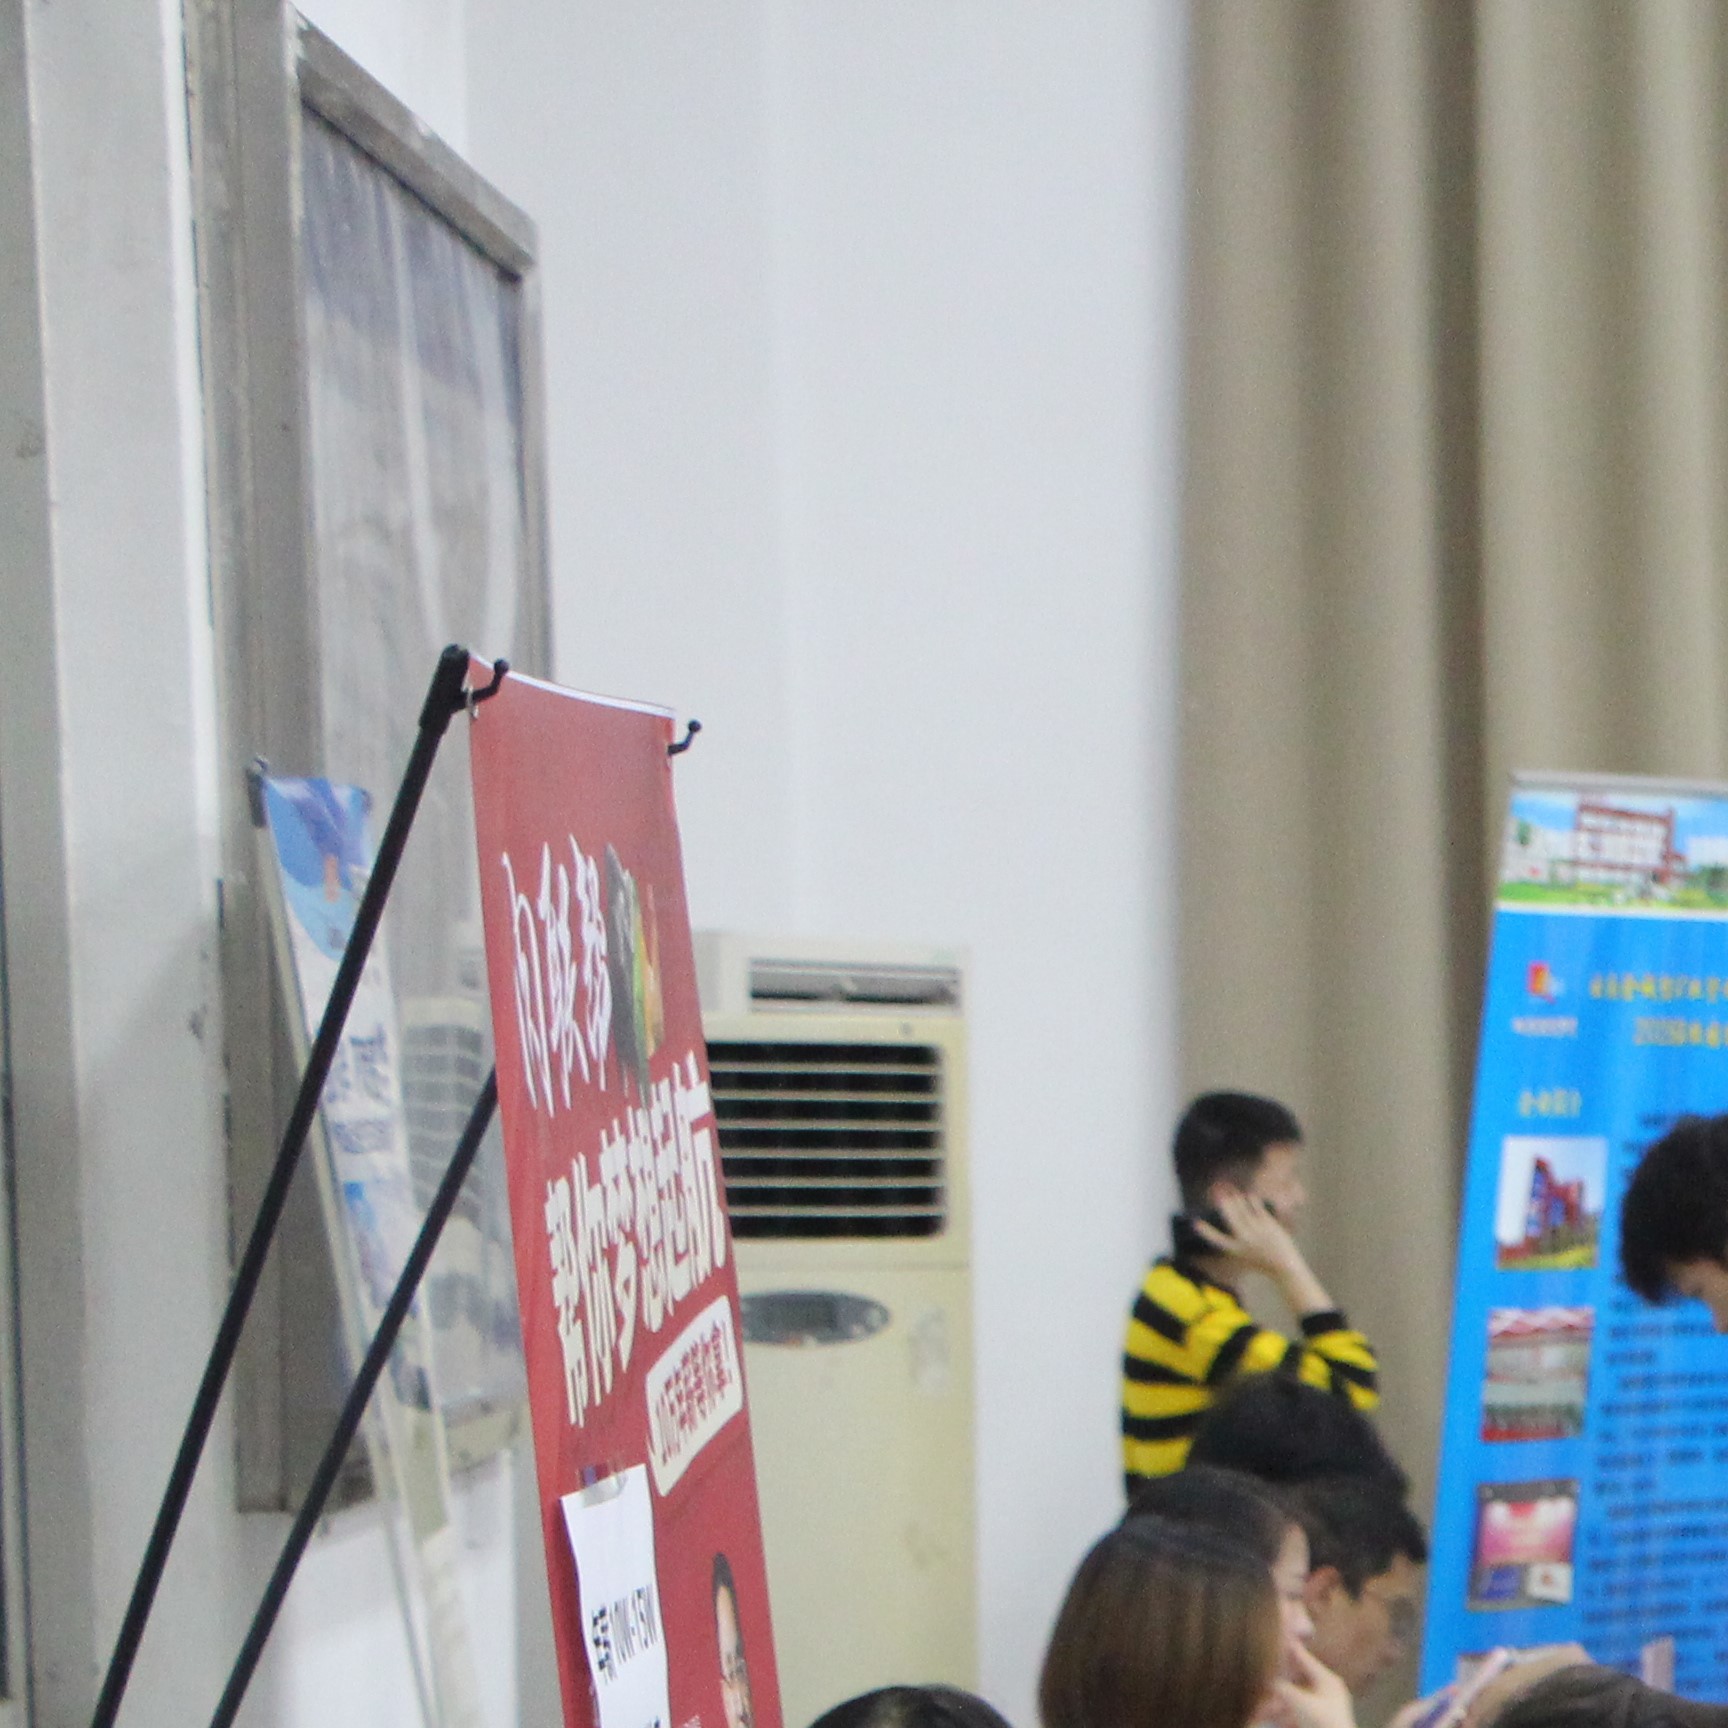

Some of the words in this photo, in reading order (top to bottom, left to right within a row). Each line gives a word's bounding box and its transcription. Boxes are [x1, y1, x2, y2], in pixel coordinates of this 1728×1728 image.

[546, 1050, 727, 1428] 帮你梦想起航
